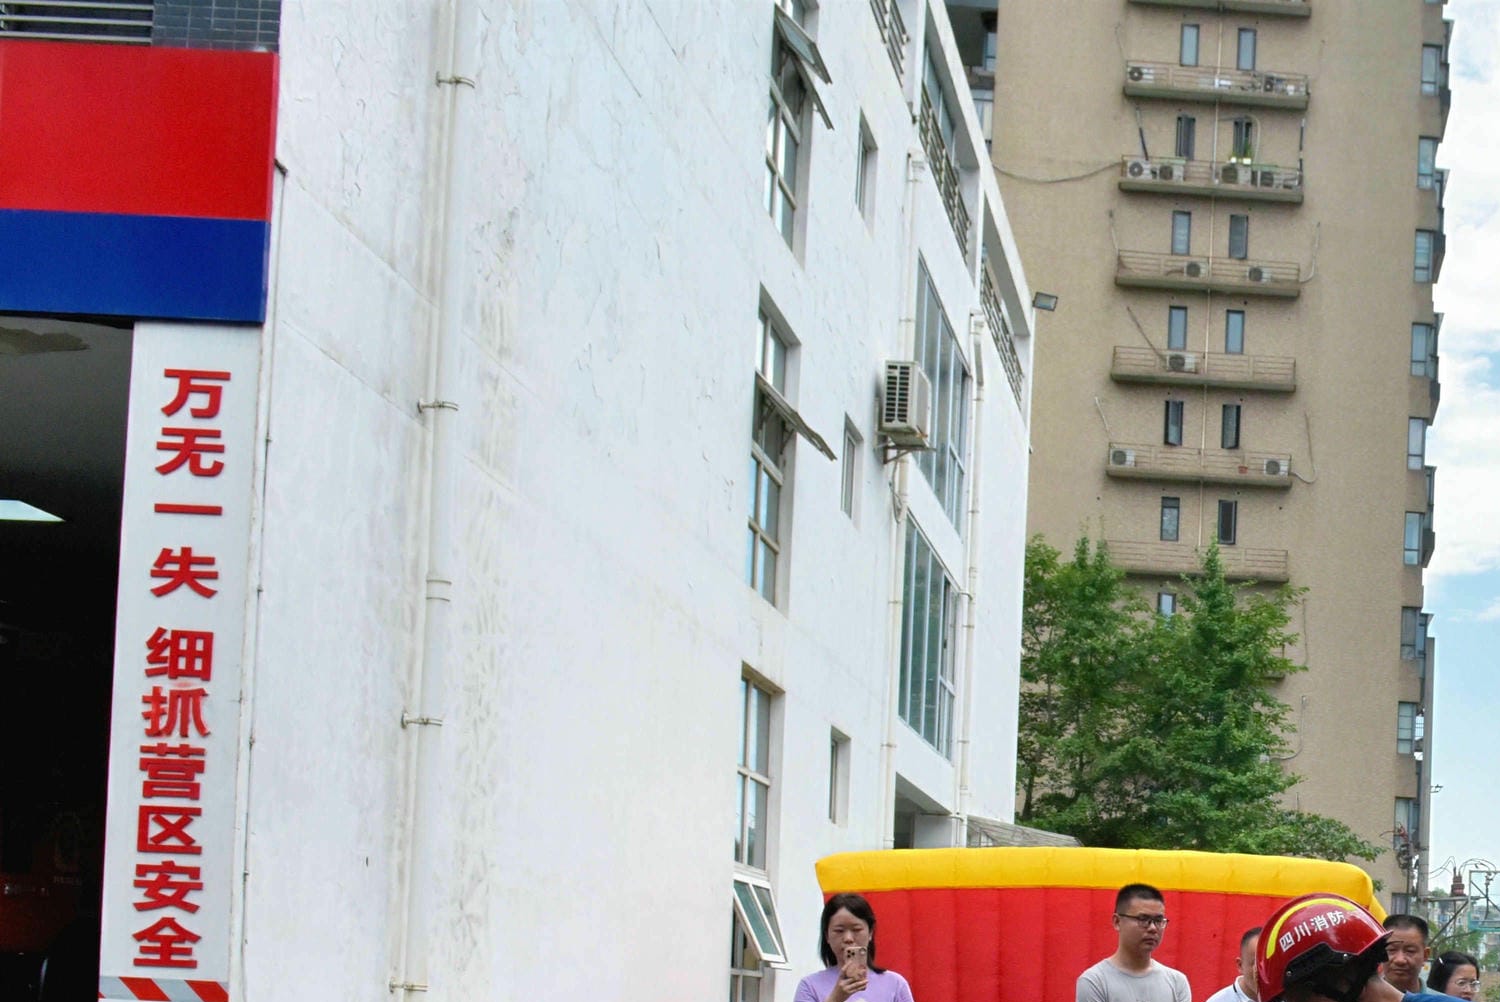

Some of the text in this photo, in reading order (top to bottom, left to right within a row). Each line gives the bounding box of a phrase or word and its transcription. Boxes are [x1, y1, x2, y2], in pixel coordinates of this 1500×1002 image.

[133, 368, 231, 969] 万无一失 细抓营区安全
[1279, 910, 1347, 952] 四川消防
